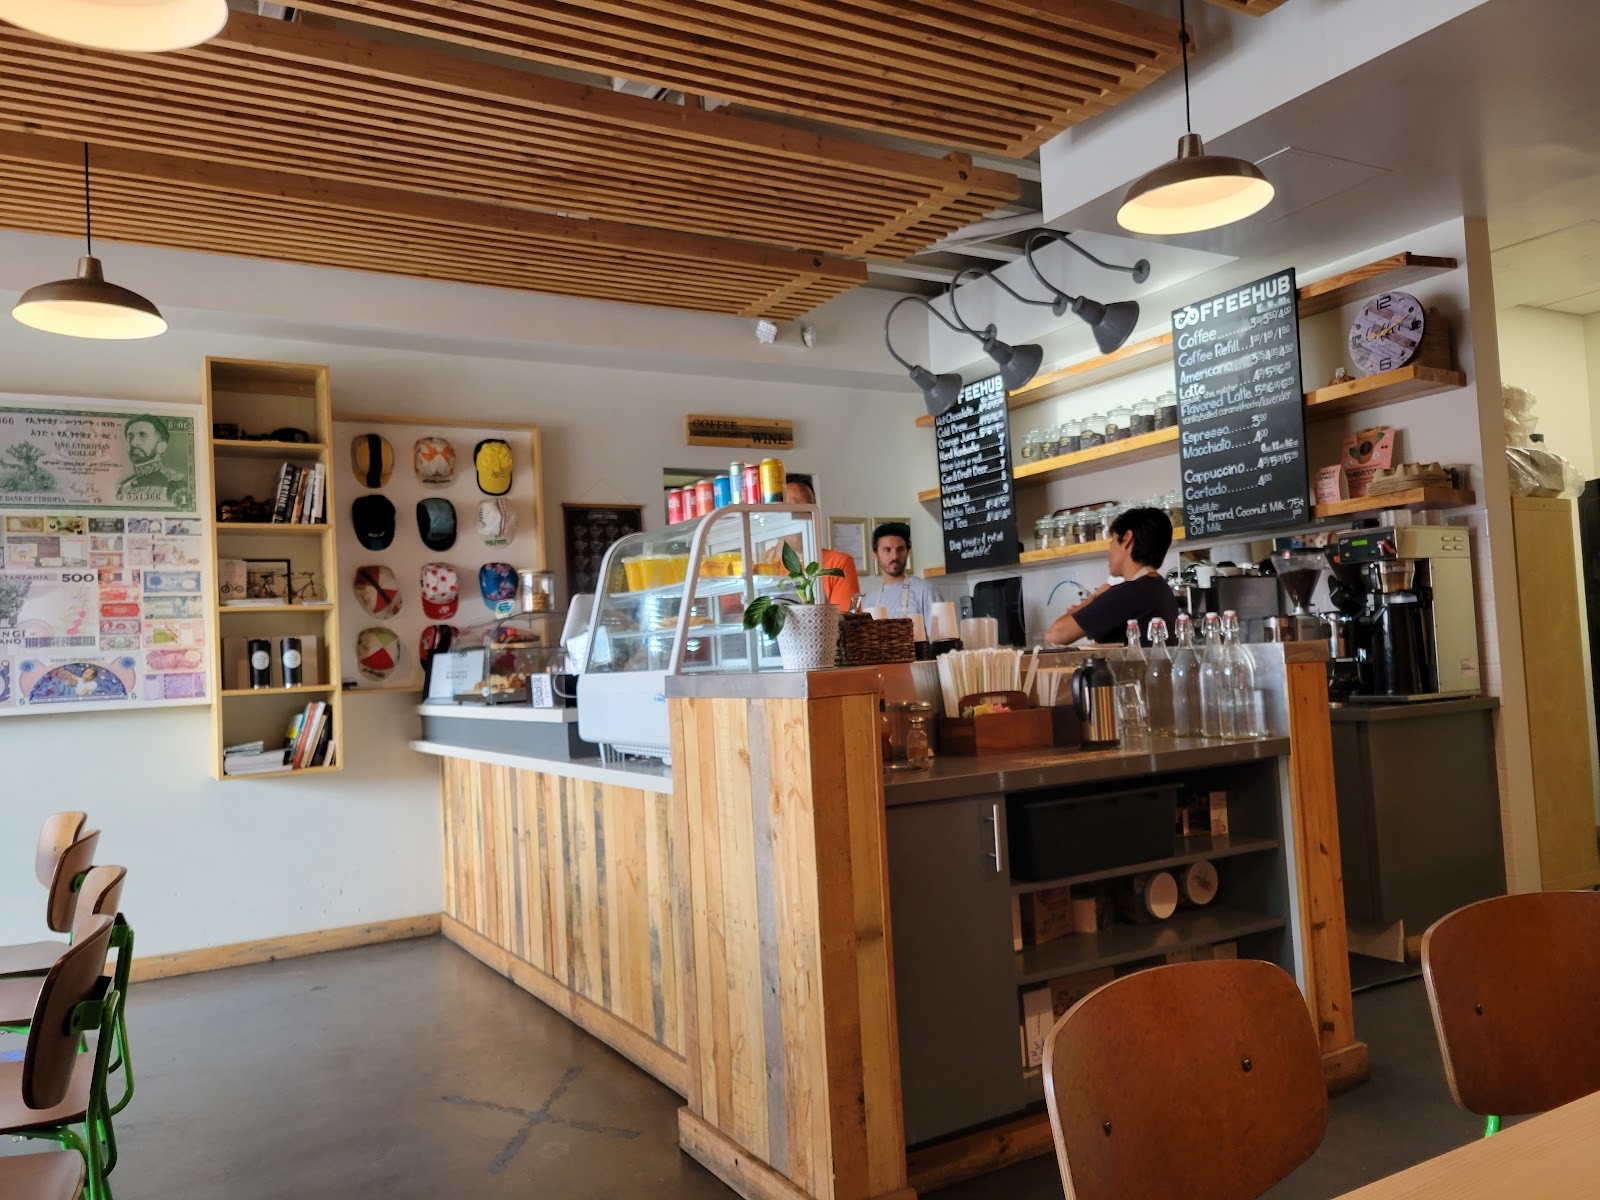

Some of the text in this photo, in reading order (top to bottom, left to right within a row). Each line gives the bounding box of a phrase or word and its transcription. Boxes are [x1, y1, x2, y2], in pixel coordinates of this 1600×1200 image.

[1376, 295, 1392, 311] 12
[1178, 328, 1217, 350] Coffee
[1178, 350, 1213, 368] Coffee
[1214, 338, 1240, 358] Refill
[1379, 357, 1392, 371] 6
[1180, 362, 1234, 386] Americano
[957, 374, 1004, 405] FEEHUB
[1179, 383, 1206, 400] Latte
[1181, 391, 1224, 417] Flavored
[1227, 386, 1253, 405] Latte
[937, 425, 951, 438] Cold
[1182, 426, 1230, 445] Espresso
[938, 436, 960, 449] Orange
[1183, 438, 1231, 459] Macchiato
[1184, 462, 1245, 484] Cappuccino
[277, 474, 292, 509] TARTINE
[1185, 482, 1227, 500] Cortado
[963, 503, 976, 515] Tea
[1235, 503, 1268, 518] Coconut
[1269, 501, 1285, 512] Milk
[954, 517, 968, 529] Tea
[1190, 524, 1205, 536] Oat
[1206, 522, 1223, 533] Milk
[61, 573, 95, 583] 500
